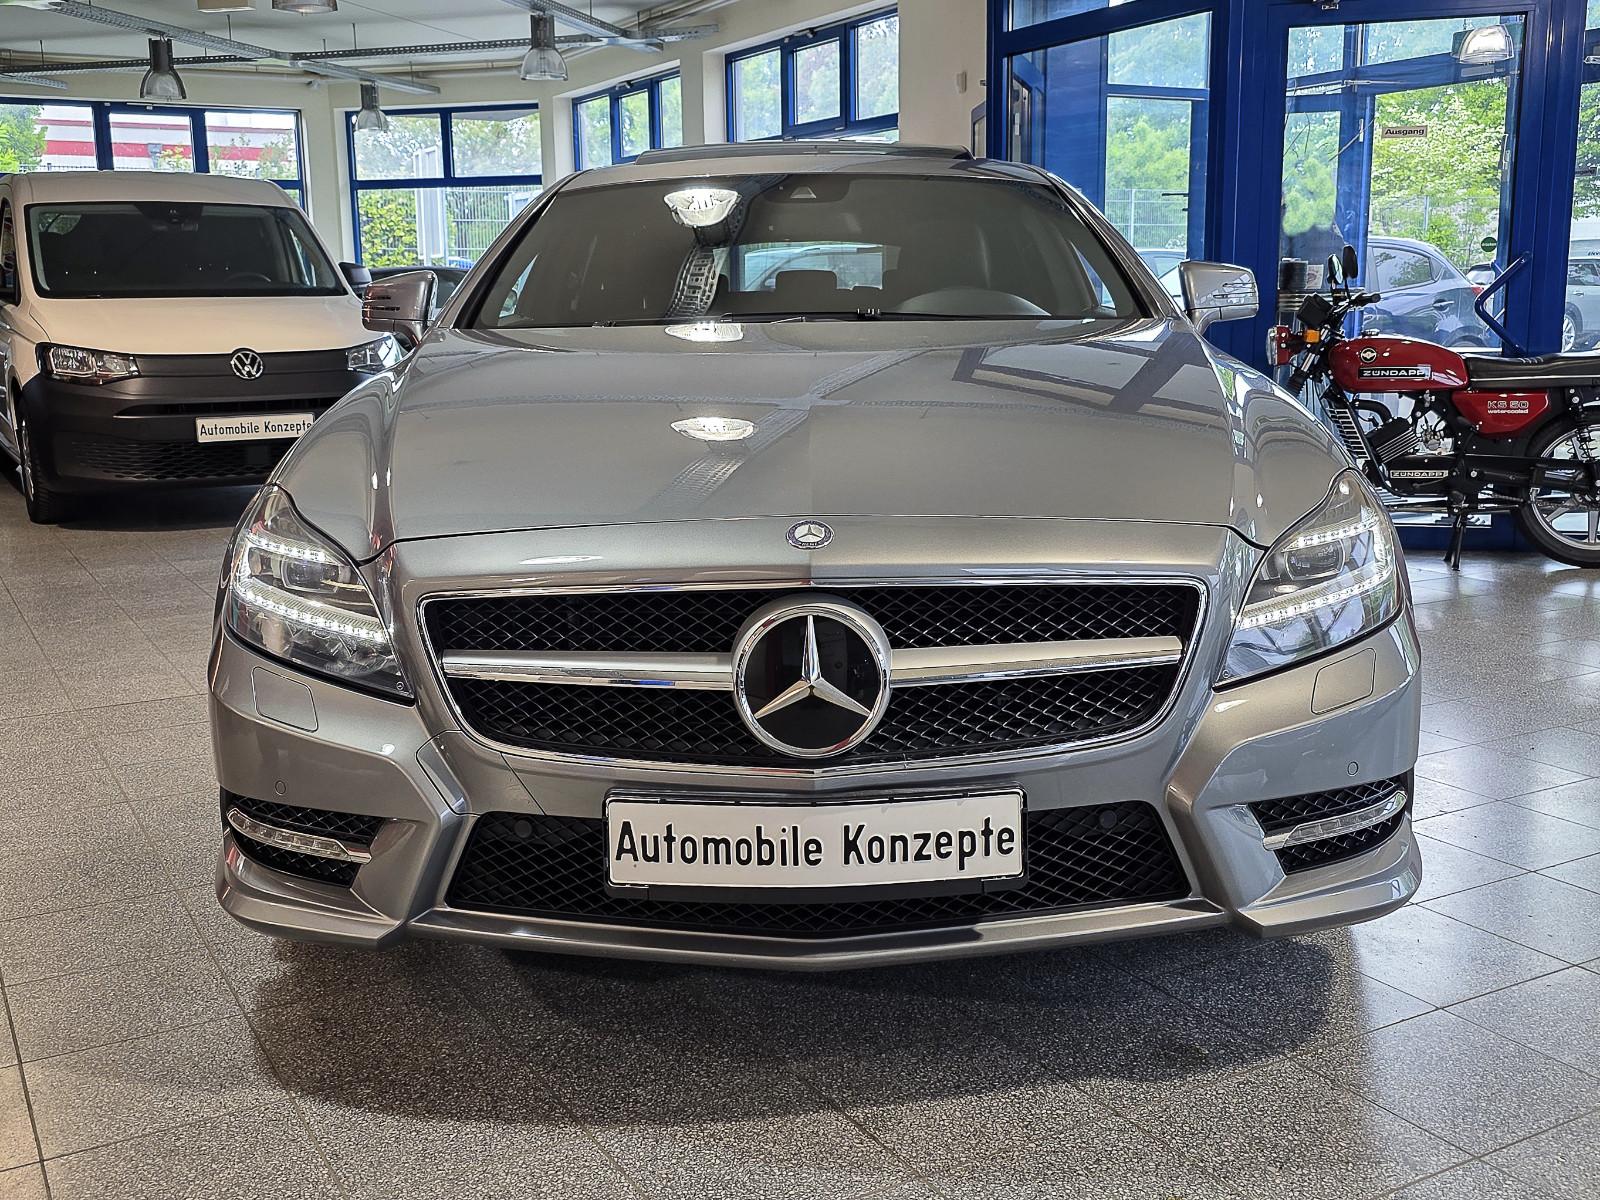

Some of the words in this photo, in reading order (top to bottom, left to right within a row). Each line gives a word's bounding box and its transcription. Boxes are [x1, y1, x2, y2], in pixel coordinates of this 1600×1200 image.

[1385, 128, 1425, 136] Ausgang
[1487, 400, 1507, 409] KS
[1509, 400, 1529, 409] 50
[200, 422, 260, 437] Automobile
[264, 419, 312, 435] Konzepte
[615, 819, 822, 867] Automobile
[842, 816, 1015, 871] Konzepte
